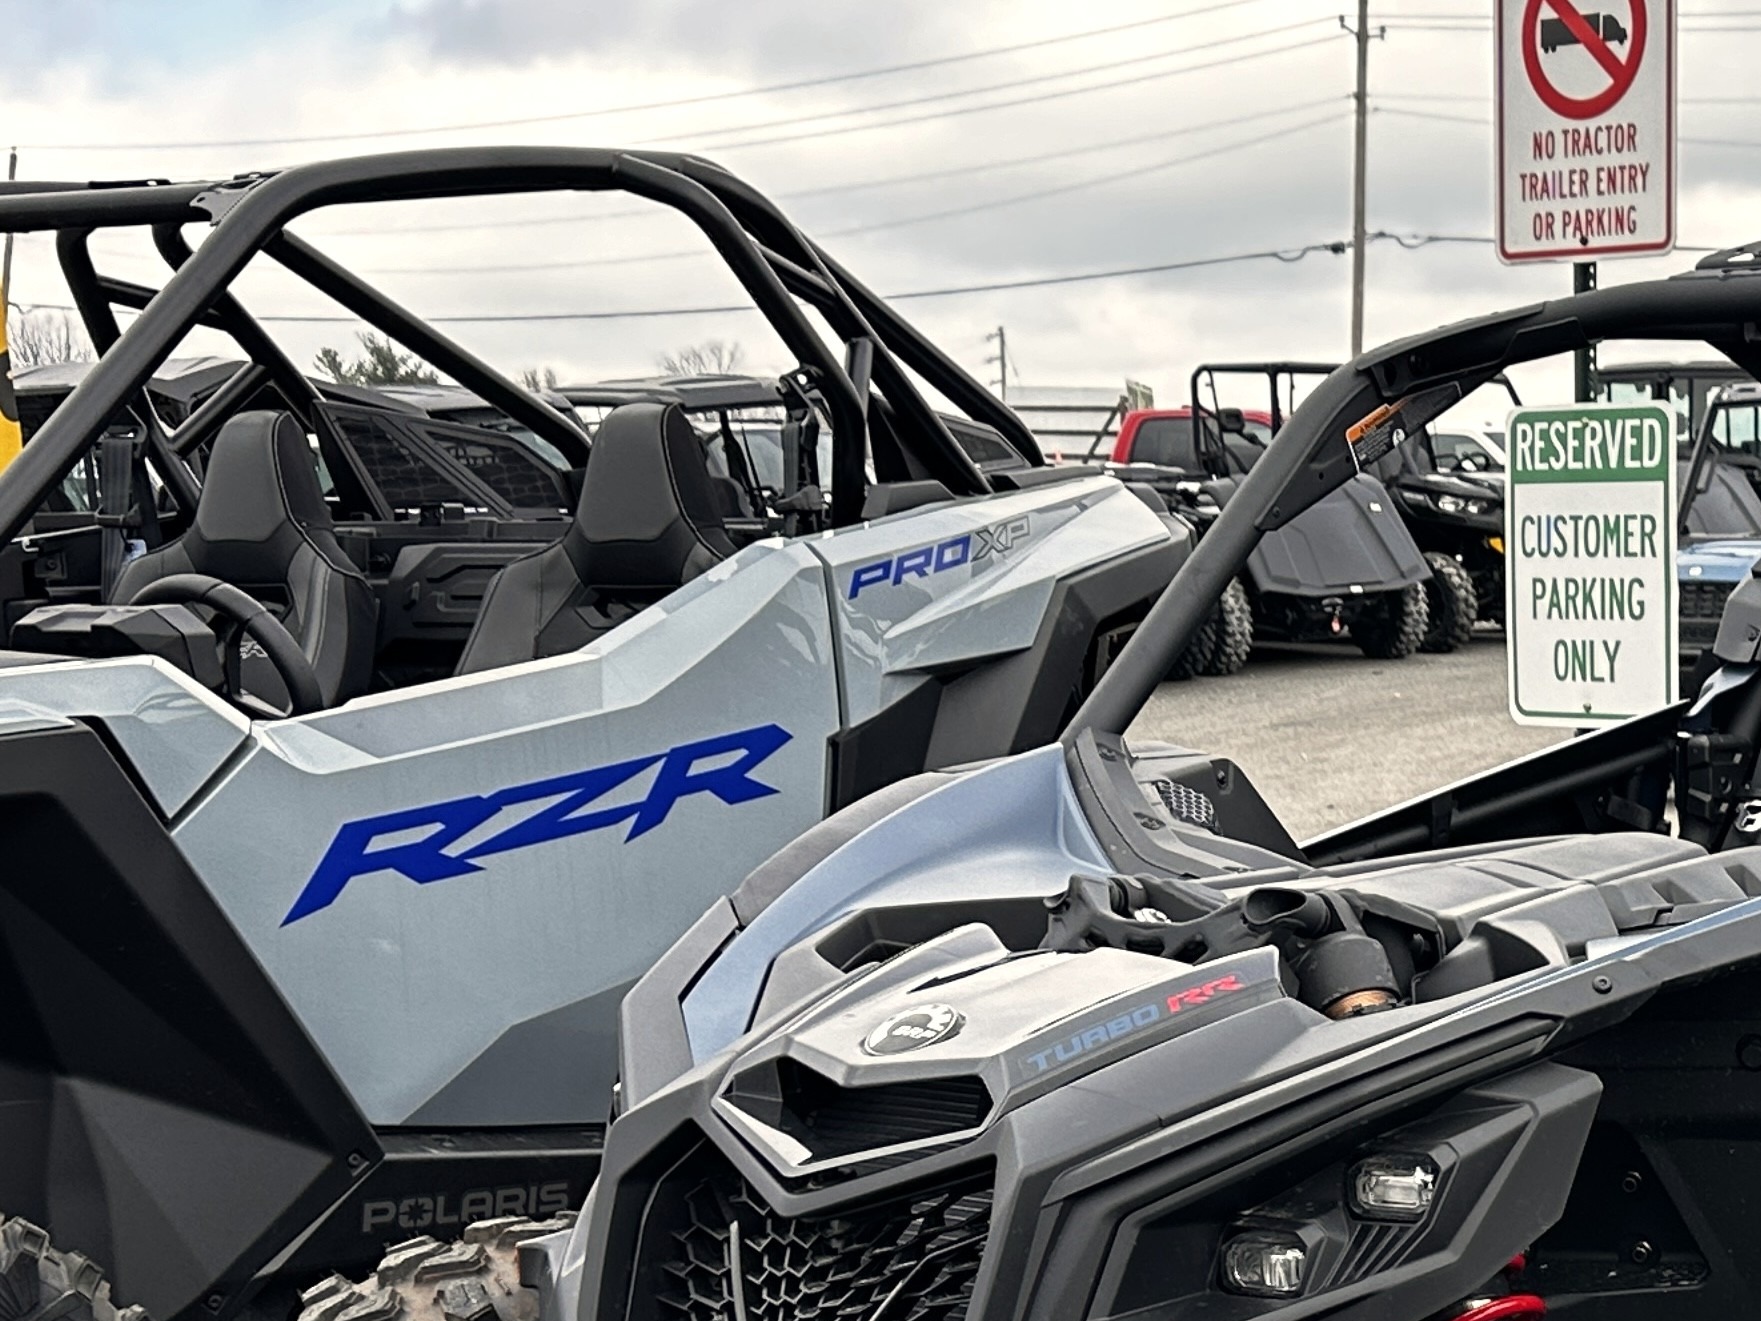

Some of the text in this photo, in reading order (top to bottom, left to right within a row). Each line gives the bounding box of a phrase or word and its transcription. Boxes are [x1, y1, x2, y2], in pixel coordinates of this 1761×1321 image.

[1533, 123, 1637, 160] NO TRACTOR
[1519, 163, 1650, 202] TRAILER ENTRY
[1533, 205, 1637, 241] OR PARKING
[1515, 417, 1663, 472] RESERVED
[848, 515, 1031, 600] PRO XP
[1520, 513, 1658, 559] CUSTOMER
[1531, 577, 1646, 621] PARKING
[1553, 639, 1622, 683] ONLY
[279, 723, 795, 928] RZR
[1026, 974, 1246, 1072] TURBO RR
[361, 1182, 570, 1233] POLARIS
